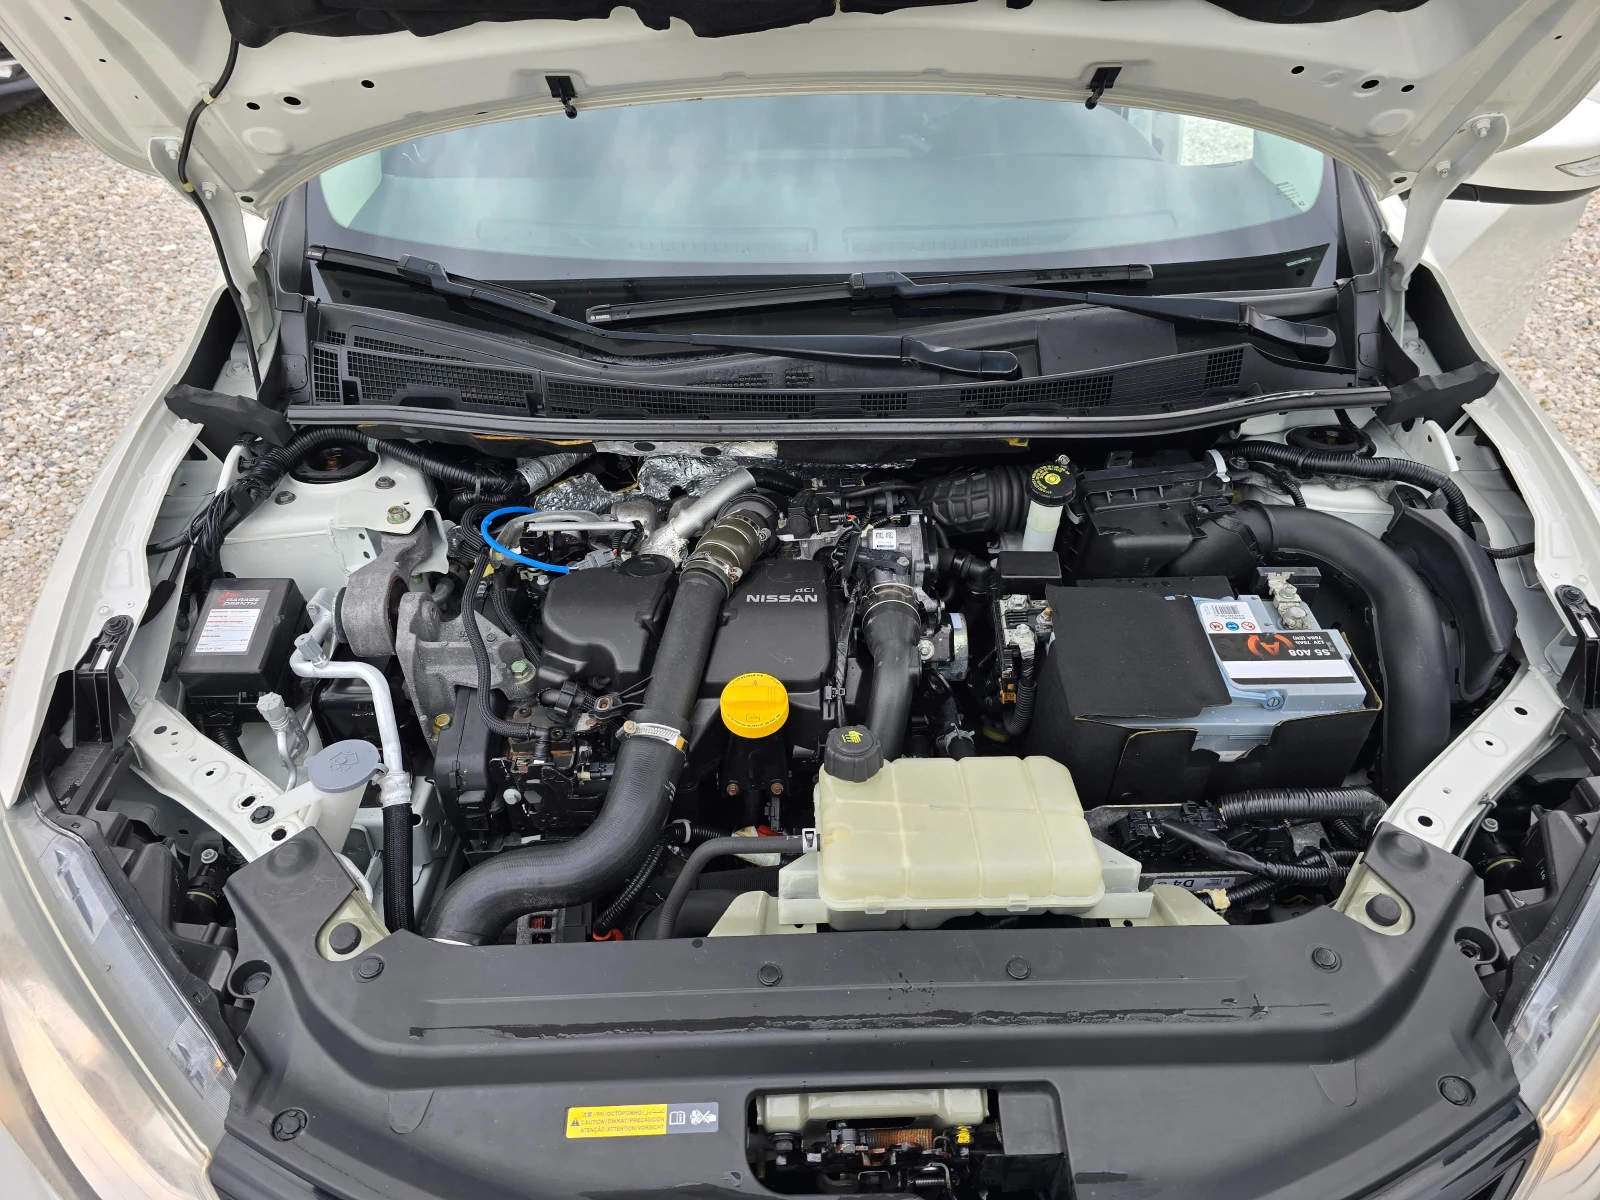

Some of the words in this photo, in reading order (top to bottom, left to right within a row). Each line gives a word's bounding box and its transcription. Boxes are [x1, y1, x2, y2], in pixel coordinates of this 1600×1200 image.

[746, 594, 818, 603] NISSAN
[1288, 648, 1311, 656] A08
[1314, 648, 1331, 656] S5
